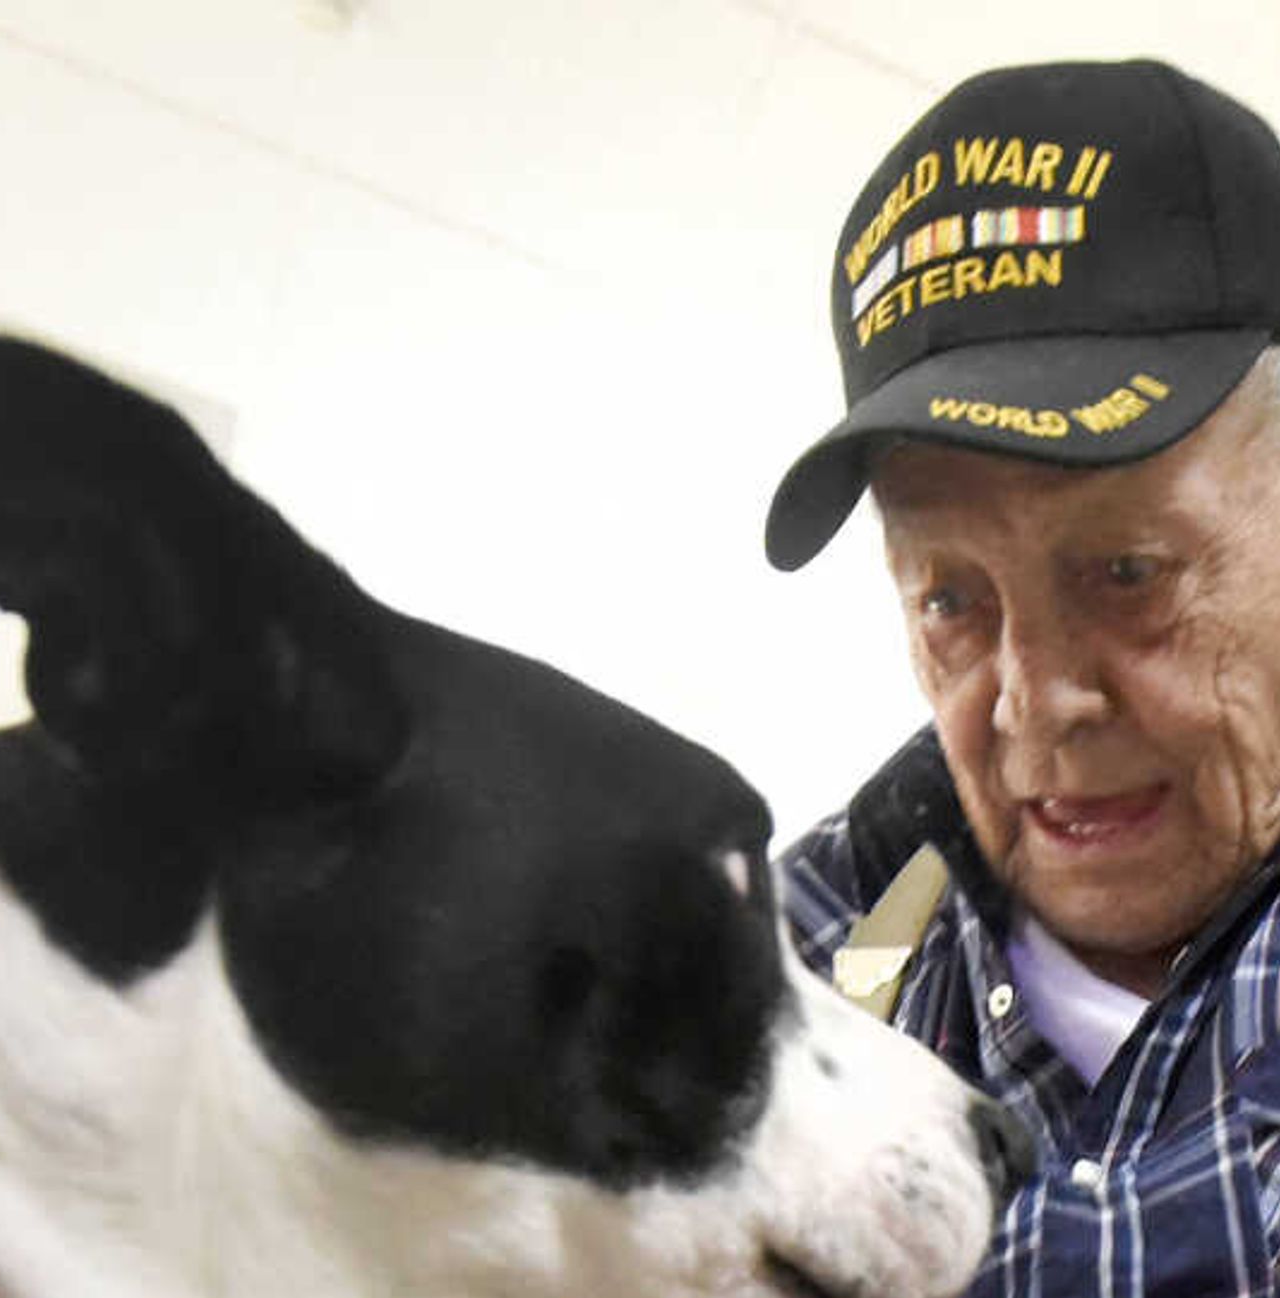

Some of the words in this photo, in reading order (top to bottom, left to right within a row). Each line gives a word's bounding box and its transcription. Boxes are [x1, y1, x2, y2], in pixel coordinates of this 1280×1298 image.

[844, 151, 940, 286] WORLD
[954, 136, 1063, 192] WAR
[1066, 145, 1112, 200] II
[856, 249, 1063, 346] VETERAN
[930, 397, 1069, 438] WORLD
[1071, 387, 1150, 434] WAR
